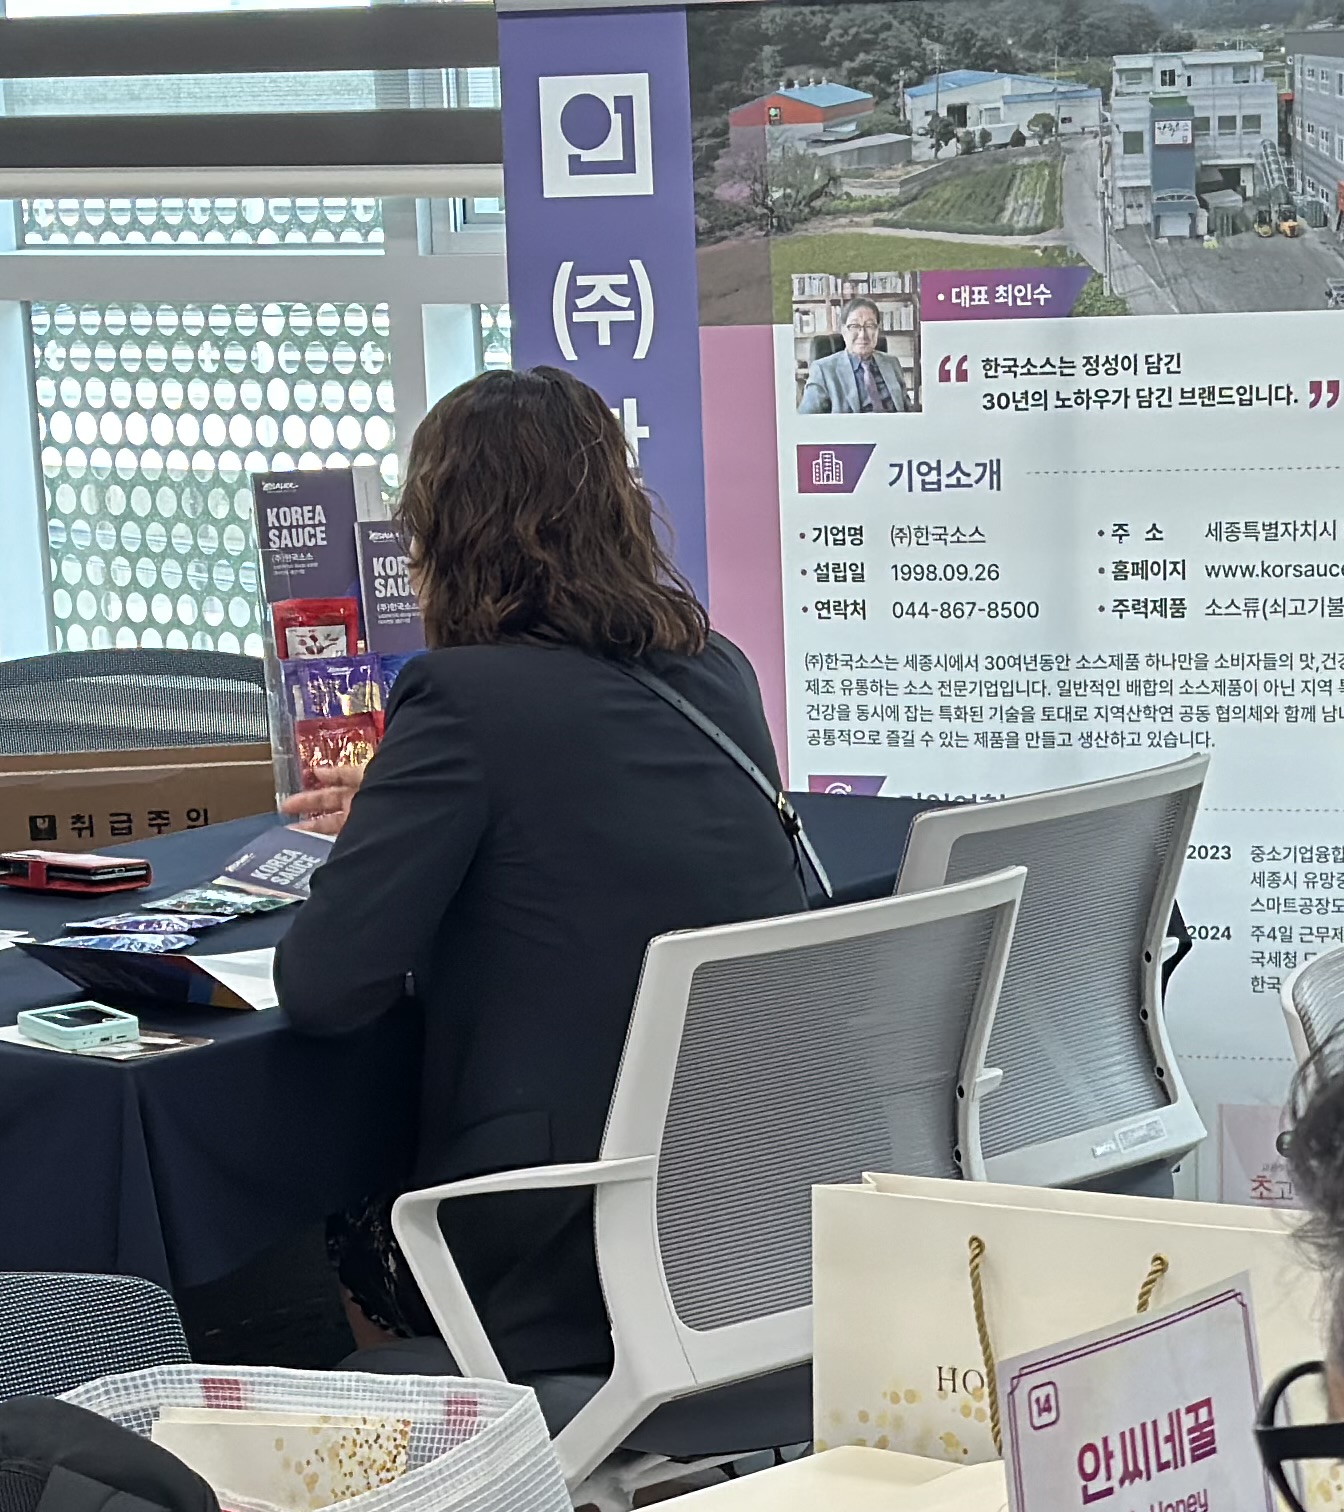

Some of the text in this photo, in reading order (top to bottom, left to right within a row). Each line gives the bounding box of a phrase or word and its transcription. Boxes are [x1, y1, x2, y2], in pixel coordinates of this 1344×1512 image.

[951, 283, 1052, 307] 대표 최인수
[982, 353, 1182, 378] 한국소스는 정성이 담긴
[982, 385, 1298, 412] 30년의 노하우가 담긴 브랜드입니다.
[888, 459, 1003, 493] 기업소개
[267, 505, 326, 527] KOREA
[269, 527, 327, 549] SAUCE
[812, 526, 864, 546] 기업명
[1204, 520, 1337, 543] 세종특별자치시
[814, 562, 999, 583] 설립일 1998.09.26
[1111, 559, 1187, 581] 홈페이지
[814, 600, 1039, 620] 연락처 044-867-8500
[1111, 597, 1187, 619] 주력제품
[805, 653, 897, 672] (주)한국소스는
[904, 653, 979, 672] 세종시에서
[985, 653, 1070, 672] 30여년동안
[1075, 653, 1139, 672] 소스제품
[1145, 651, 1209, 672] 하나만을
[1215, 651, 1293, 672] 소비자들의
[805, 679, 834, 698] 제조
[840, 679, 898, 698] 유통하는
[904, 679, 932, 698] 소스
[938, 679, 1051, 698] 전문기업입니다.
[1057, 679, 1120, 698] 일반적인
[1127, 679, 1173, 698] 배합의
[1179, 678, 1258, 697] 소스제품이
[1264, 678, 1295, 697] 아닌
[1301, 678, 1331, 697] 지역
[807, 705, 851, 723] 건강을
[857, 705, 899, 723] 동시에
[904, 705, 933, 723] 잡는
[939, 705, 984, 723] 특화된
[989, 705, 1035, 723] 기술을
[1042, 705, 1088, 723] 토대로
[1094, 705, 1173, 723] 지역산학연
[1179, 705, 1210, 723] 공동
[1216, 705, 1278, 723] 협의체와
[1285, 705, 1316, 723] 함께
[807, 730, 1215, 749] 공통적으로 즐길 수 있는 제품을 만들고 생산하고 있습니다.
[1187, 846, 1232, 860] 2023
[251, 849, 302, 880] KOREA
[271, 854, 321, 885] SAUCE
[1251, 872, 1298, 890] 세종시
[1187, 927, 1232, 940] 2024
[1251, 926, 1293, 943] 주4일
[1251, 951, 1297, 969] 국세청
[1033, 1392, 1053, 1419] 14
[1076, 1396, 1219, 1505] 안씨네꿀
